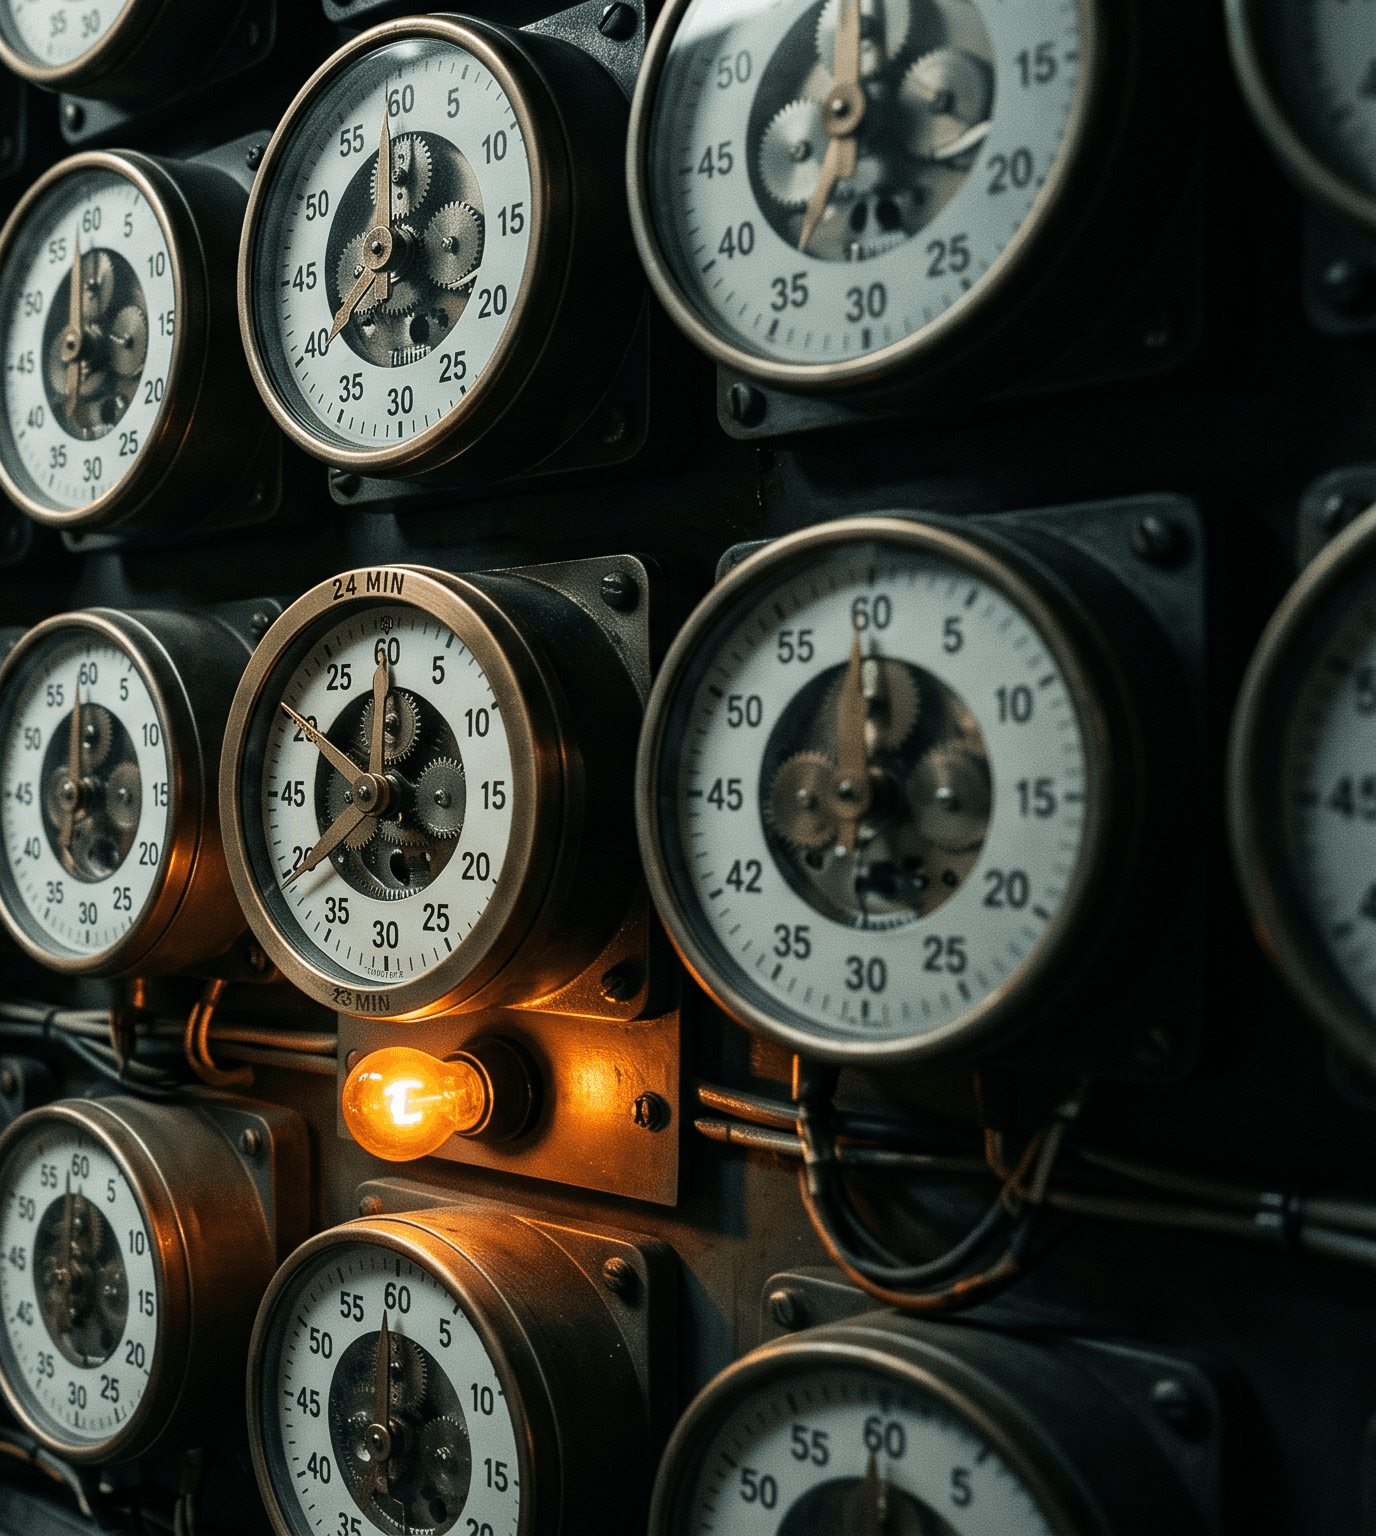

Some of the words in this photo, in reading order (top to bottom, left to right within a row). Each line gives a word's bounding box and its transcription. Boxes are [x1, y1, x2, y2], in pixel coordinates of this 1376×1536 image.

[716, 50, 751, 89] 50
[1015, 42, 1057, 88] 15
[388, 85, 415, 118] 60
[447, 88, 460, 118] 5
[339, 125, 365, 157] 55
[481, 130, 508, 164] 10
[698, 141, 733, 179] 45
[987, 148, 1034, 195] 20
[83, 206, 101, 232] 60
[306, 190, 329, 221] 50
[497, 202, 525, 236] 15
[124, 213, 133, 238] 5
[718, 221, 755, 259] 40
[49, 238, 66, 264] 55
[147, 251, 165, 278] 10
[927, 234, 970, 278] 25
[292, 262, 318, 292] 45
[23, 291, 43, 316] 50
[478, 285, 507, 319] 20
[771, 273, 808, 312] 35
[845, 282, 887, 324] 30
[158, 310, 175, 337] 15
[304, 329, 329, 358] 40
[16, 351, 35, 375] 45
[438, 351, 466, 383] 25
[144, 378, 164, 405] 20
[338, 372, 364, 403] 35
[387, 385, 413, 415] 30
[27, 406, 44, 429] 40
[50, 444, 67, 469] 35
[119, 430, 138, 457] 25
[83, 456, 102, 481] 30
[332, 573, 357, 600] 24
[366, 571, 404, 595] MIN
[851, 595, 892, 632] 60
[777, 629, 815, 664] 55
[943, 617, 963, 654] 5
[374, 637, 400, 666] 60
[80, 663, 98, 685] 60
[327, 664, 352, 691] 25
[432, 655, 445, 684] 5
[47, 685, 64, 707] 55
[120, 678, 129, 701] 5
[727, 695, 763, 729] 50
[995, 685, 1034, 724] 10
[142, 723, 159, 747] 10
[464, 707, 490, 738] 10
[24, 727, 41, 751] 50
[15, 783, 33, 806] 45
[152, 782, 169, 807] 15
[281, 780, 306, 807] 45
[480, 780, 506, 810] 15
[706, 778, 744, 811] 45
[1015, 778, 1057, 818] 15
[23, 837, 40, 860] 40
[139, 842, 159, 866] 20
[461, 852, 490, 881] 20
[726, 860, 762, 894] 42
[46, 881, 63, 904] 35
[113, 887, 132, 911] 25
[983, 869, 1030, 910] 20
[79, 902, 97, 925] 30
[324, 897, 350, 925] 35
[422, 903, 450, 933] 25
[372, 920, 399, 949] 30
[774, 924, 811, 959] 35
[924, 936, 967, 975] 25
[845, 956, 887, 993] 30
[355, 994, 390, 1011] MIN
[40, 1164, 58, 1189] 55
[72, 1154, 90, 1179] 60
[107, 1179, 116, 1203] 5
[18, 1196, 35, 1222] 50
[128, 1229, 144, 1256] 10
[9, 1246, 26, 1271] 45
[138, 1289, 154, 1317] 15
[340, 1291, 364, 1322] 55
[384, 1282, 411, 1314] 60
[17, 1300, 34, 1326] 40
[309, 1326, 333, 1359] 50
[439, 1318, 452, 1348] 5
[37, 1352, 55, 1379] 35
[125, 1339, 145, 1368] 20
[68, 1381, 87, 1409] 30
[101, 1374, 120, 1402] 25
[297, 1386, 320, 1418] 45
[471, 1383, 494, 1415] 10
[791, 1424, 829, 1467] 55
[863, 1416, 905, 1460] 60
[307, 1452, 331, 1484] 40
[484, 1457, 508, 1492] 15
[740, 1468, 777, 1509] 50
[950, 1467, 971, 1507] 5
[338, 1512, 362, 1536] 35
